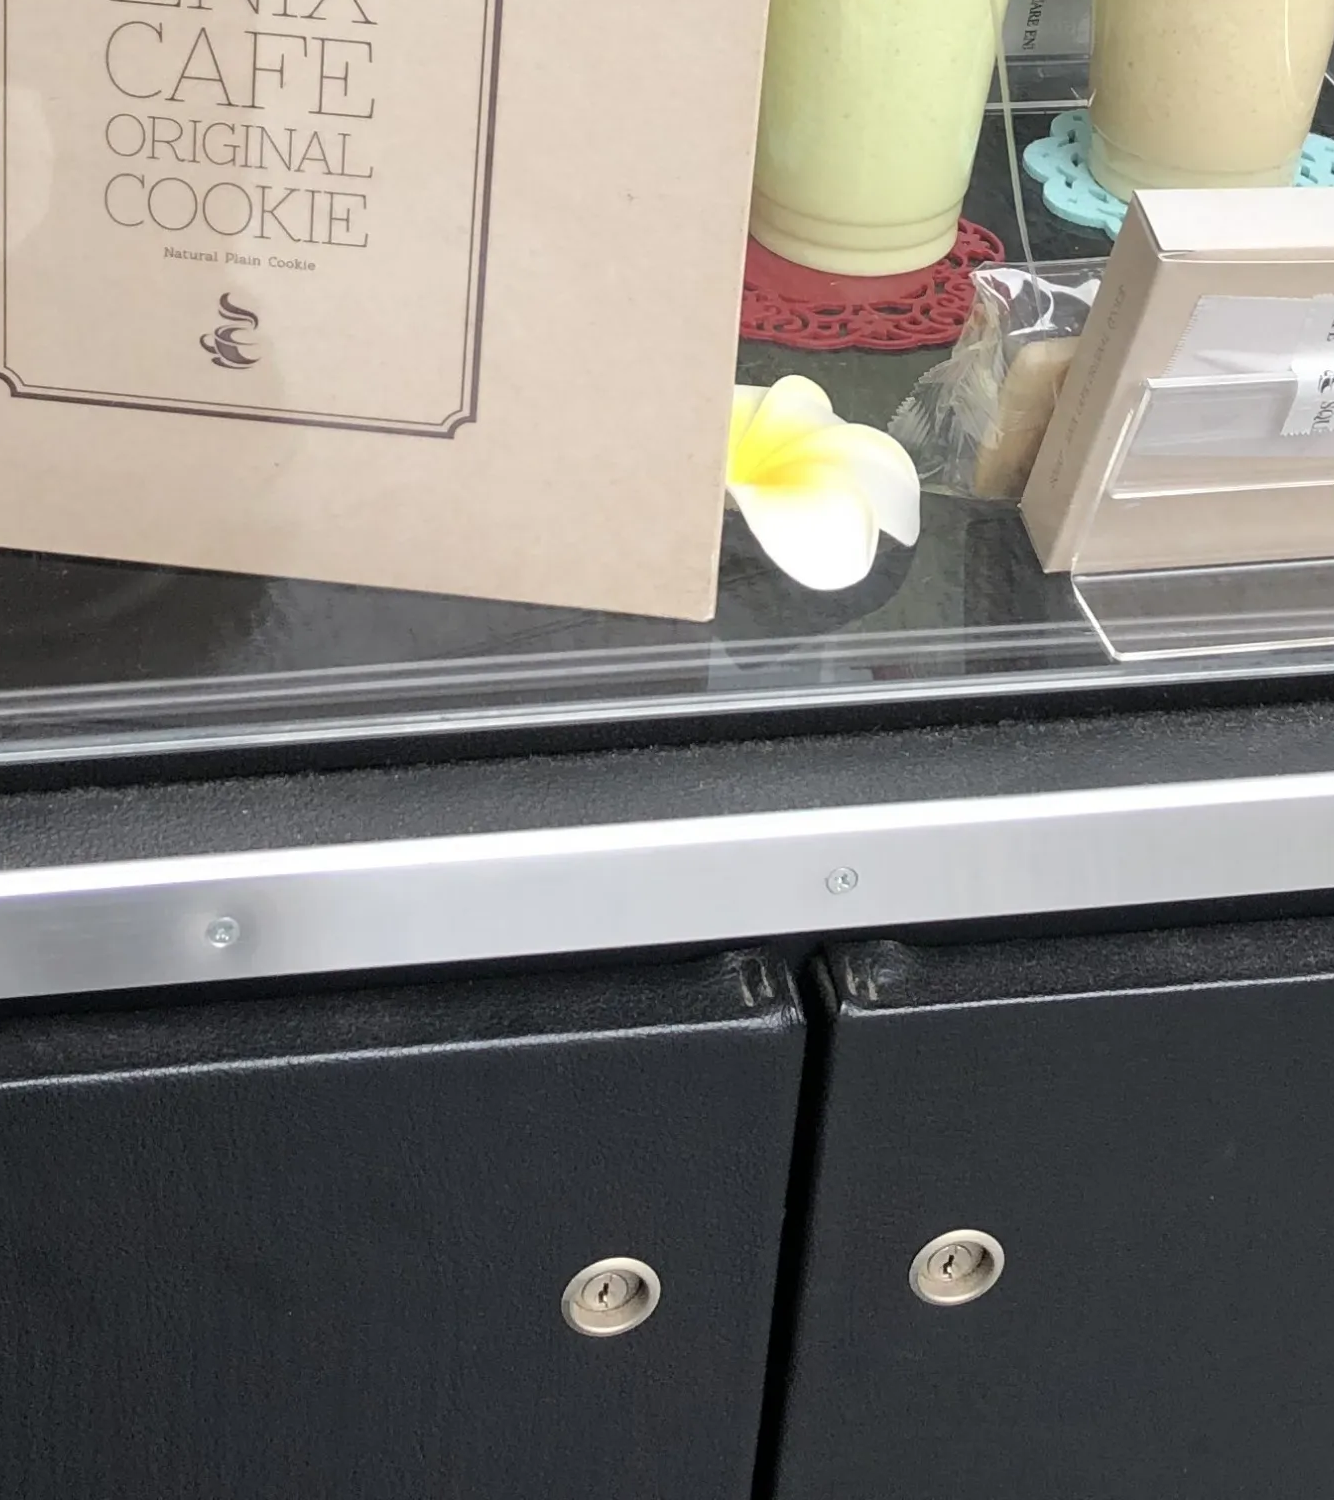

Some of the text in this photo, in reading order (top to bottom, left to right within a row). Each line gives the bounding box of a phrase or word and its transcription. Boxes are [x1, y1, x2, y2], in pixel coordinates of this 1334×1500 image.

[105, 21, 375, 118] CAFE
[105, 113, 374, 179] ORIGINAL
[104, 173, 369, 248] COOKIE
[163, 246, 317, 272] Natural Plain Cookie
